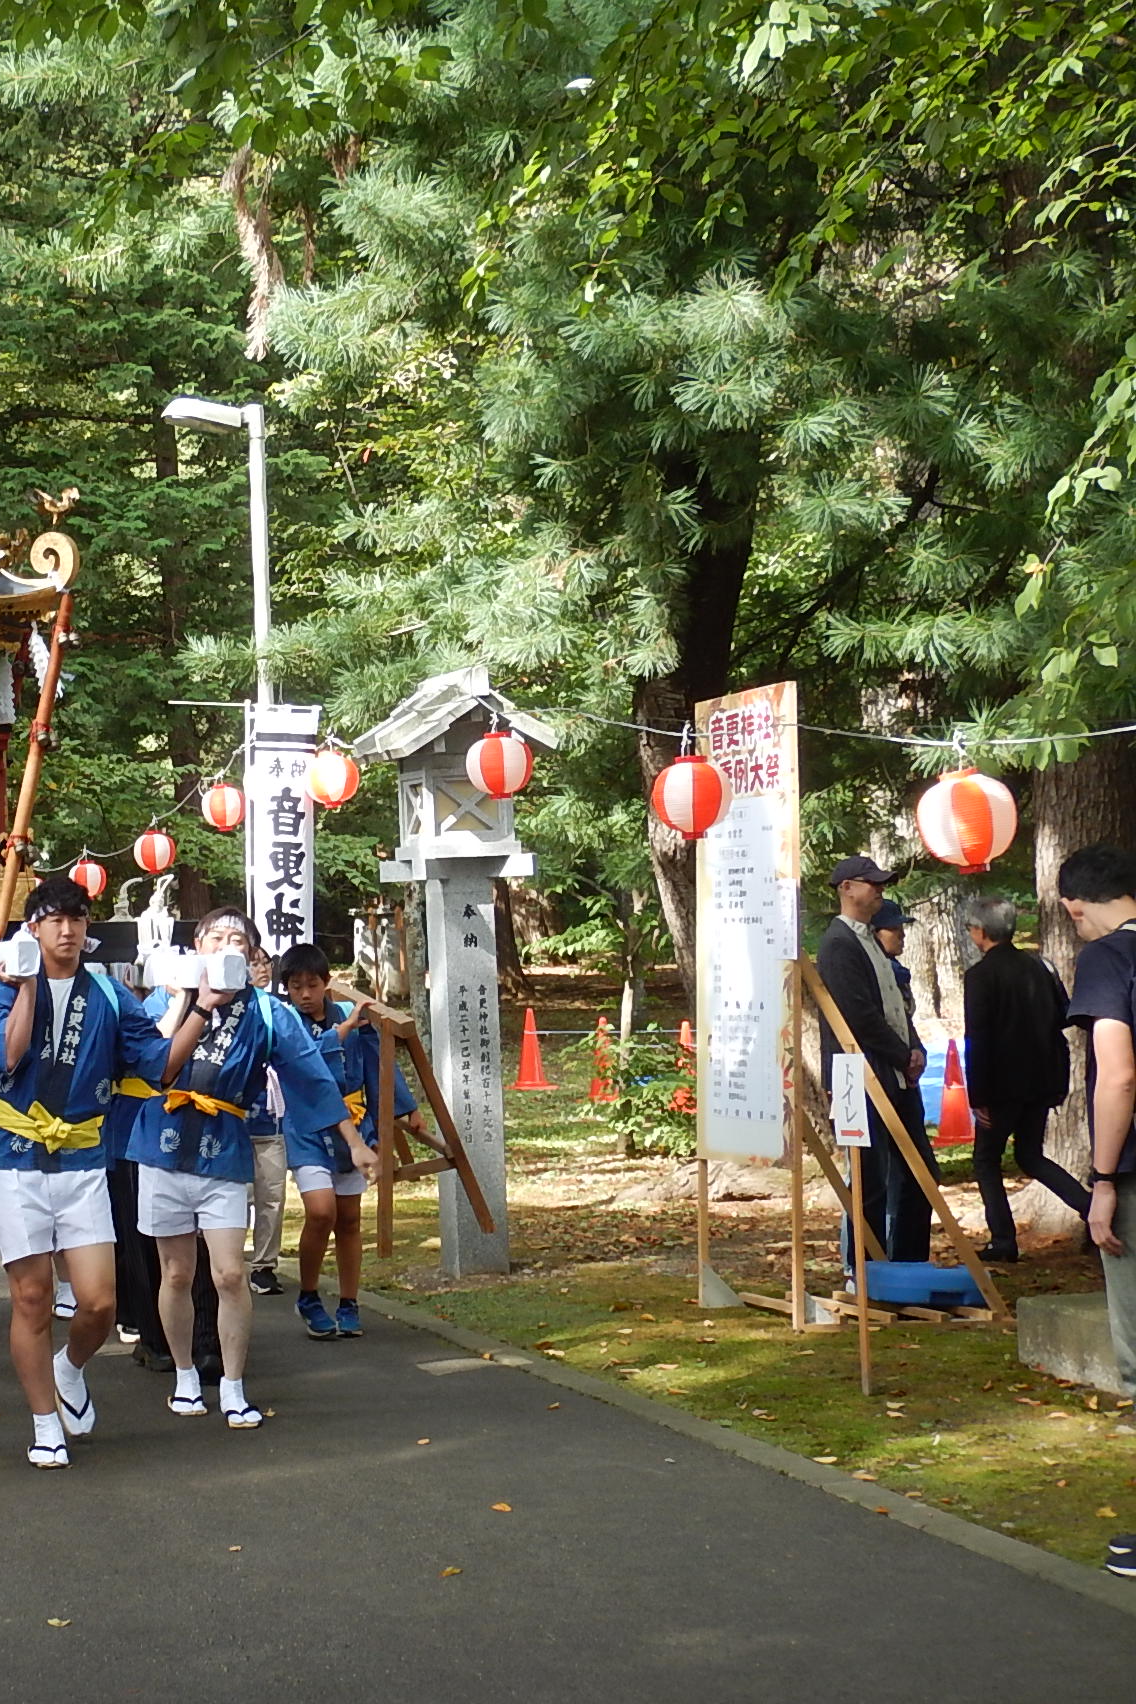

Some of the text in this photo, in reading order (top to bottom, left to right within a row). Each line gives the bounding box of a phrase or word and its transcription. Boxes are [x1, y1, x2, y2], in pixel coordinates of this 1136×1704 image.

[710, 706, 772, 751] 音更神社
[58, 995, 88, 1067] 音更神社
[207, 1000, 246, 1067] 音更神社
[842, 1063, 858, 1124] トイレ
